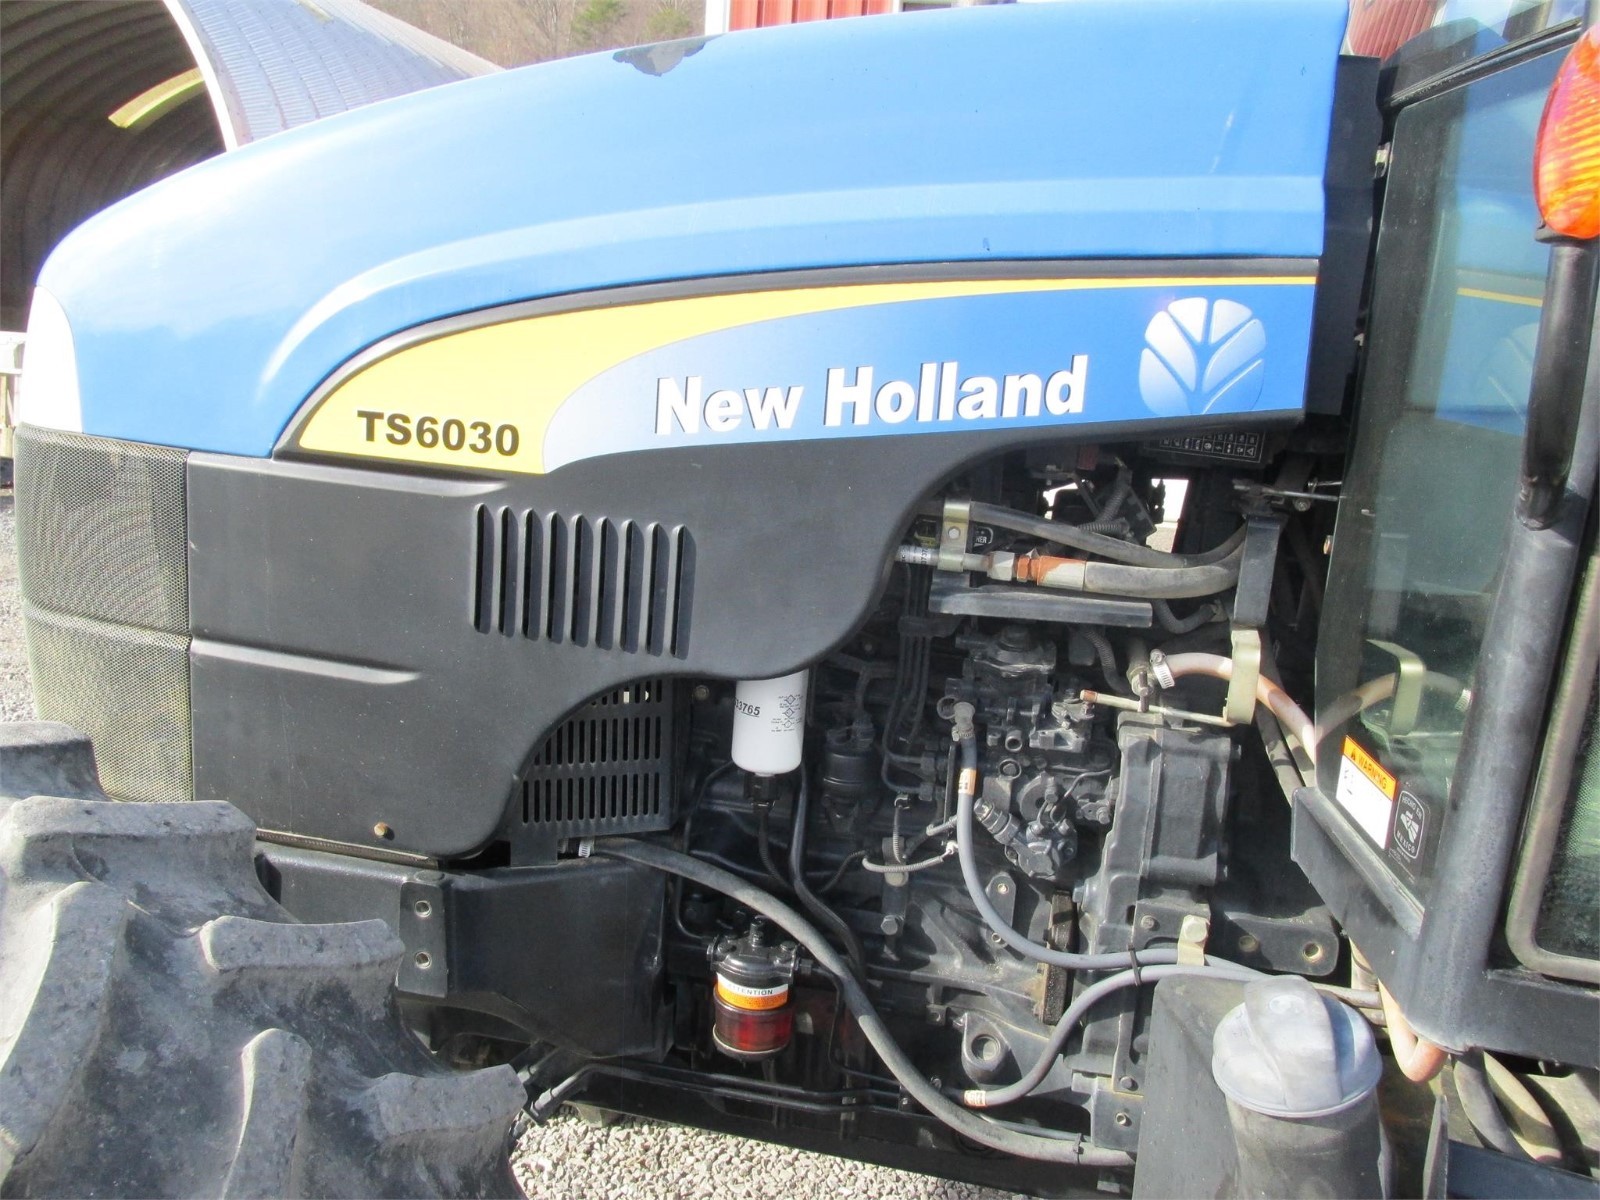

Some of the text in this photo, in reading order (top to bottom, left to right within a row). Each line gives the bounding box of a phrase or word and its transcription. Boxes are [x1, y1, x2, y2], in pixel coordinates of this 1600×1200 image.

[654, 354, 1089, 435] New Holland
[357, 410, 519, 457] TS6030
[1359, 755, 1387, 790] WARNING
[1396, 830, 1416, 854] MEXICO
